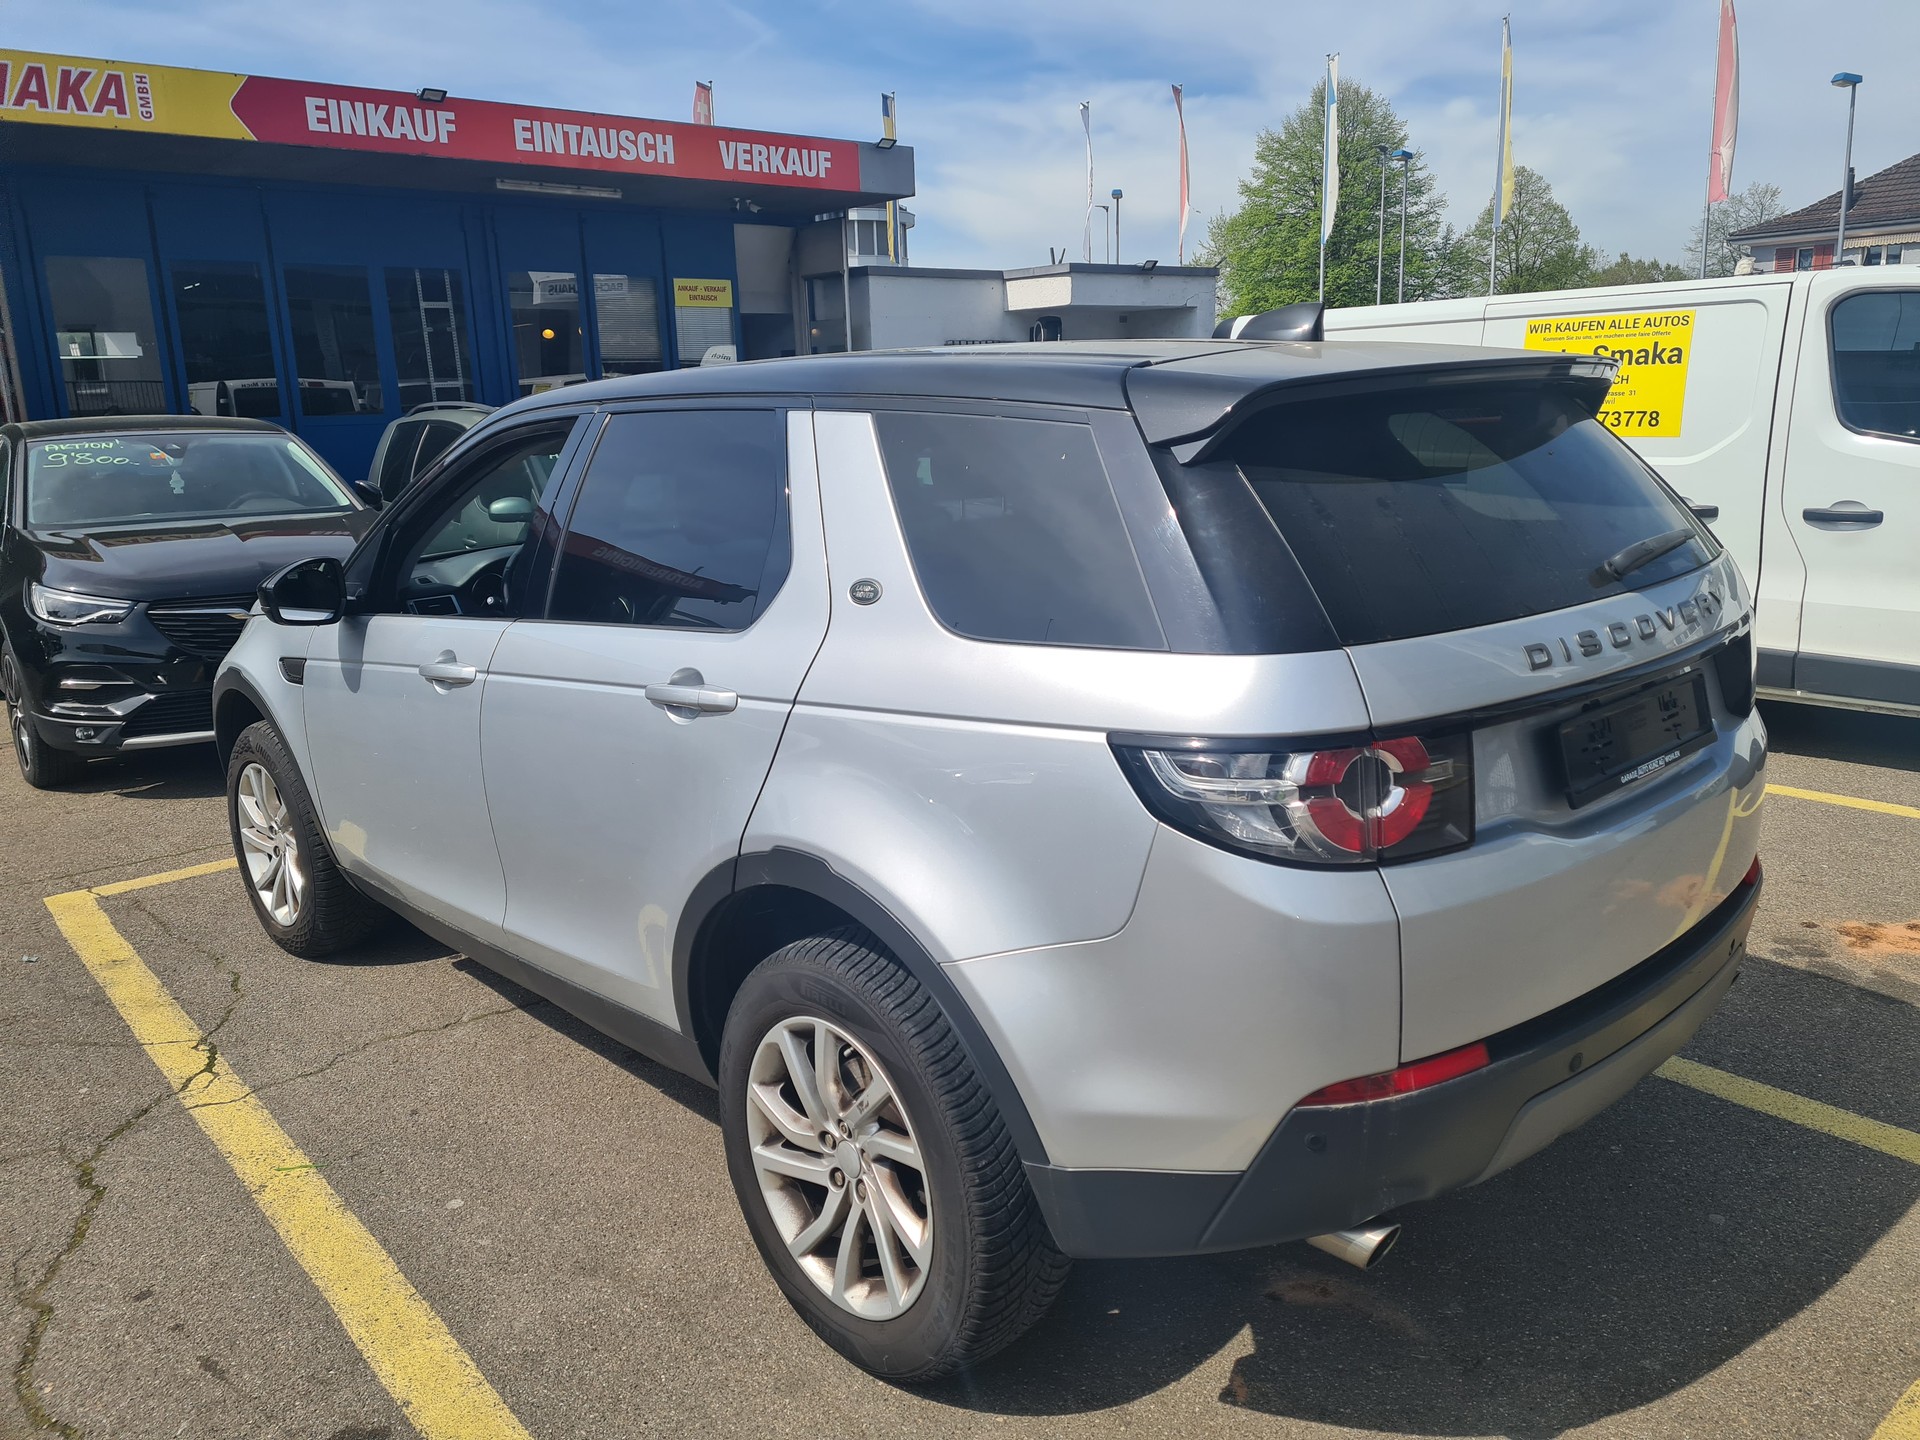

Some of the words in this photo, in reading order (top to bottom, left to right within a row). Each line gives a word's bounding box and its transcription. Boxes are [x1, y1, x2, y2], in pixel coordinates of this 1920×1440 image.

[0, 60, 130, 119] AKA
[133, 72, 155, 121] GMBH
[305, 96, 456, 144] EINKAUF
[513, 118, 675, 165] EINTAUSCH
[718, 140, 832, 178] VERKAUF
[677, 284, 699, 293] ANKAUF
[703, 285, 727, 293] VERKAUF
[688, 294, 718, 302] EINTAUSCH
[1529, 323, 1552, 334] WIR
[1555, 320, 1605, 333] KAUFEN
[1608, 318, 1640, 330] ALLE
[1643, 315, 1690, 328] AUTOS
[1604, 397, 1616, 405] wil
[1521, 591, 1723, 672] DISCOVERY
